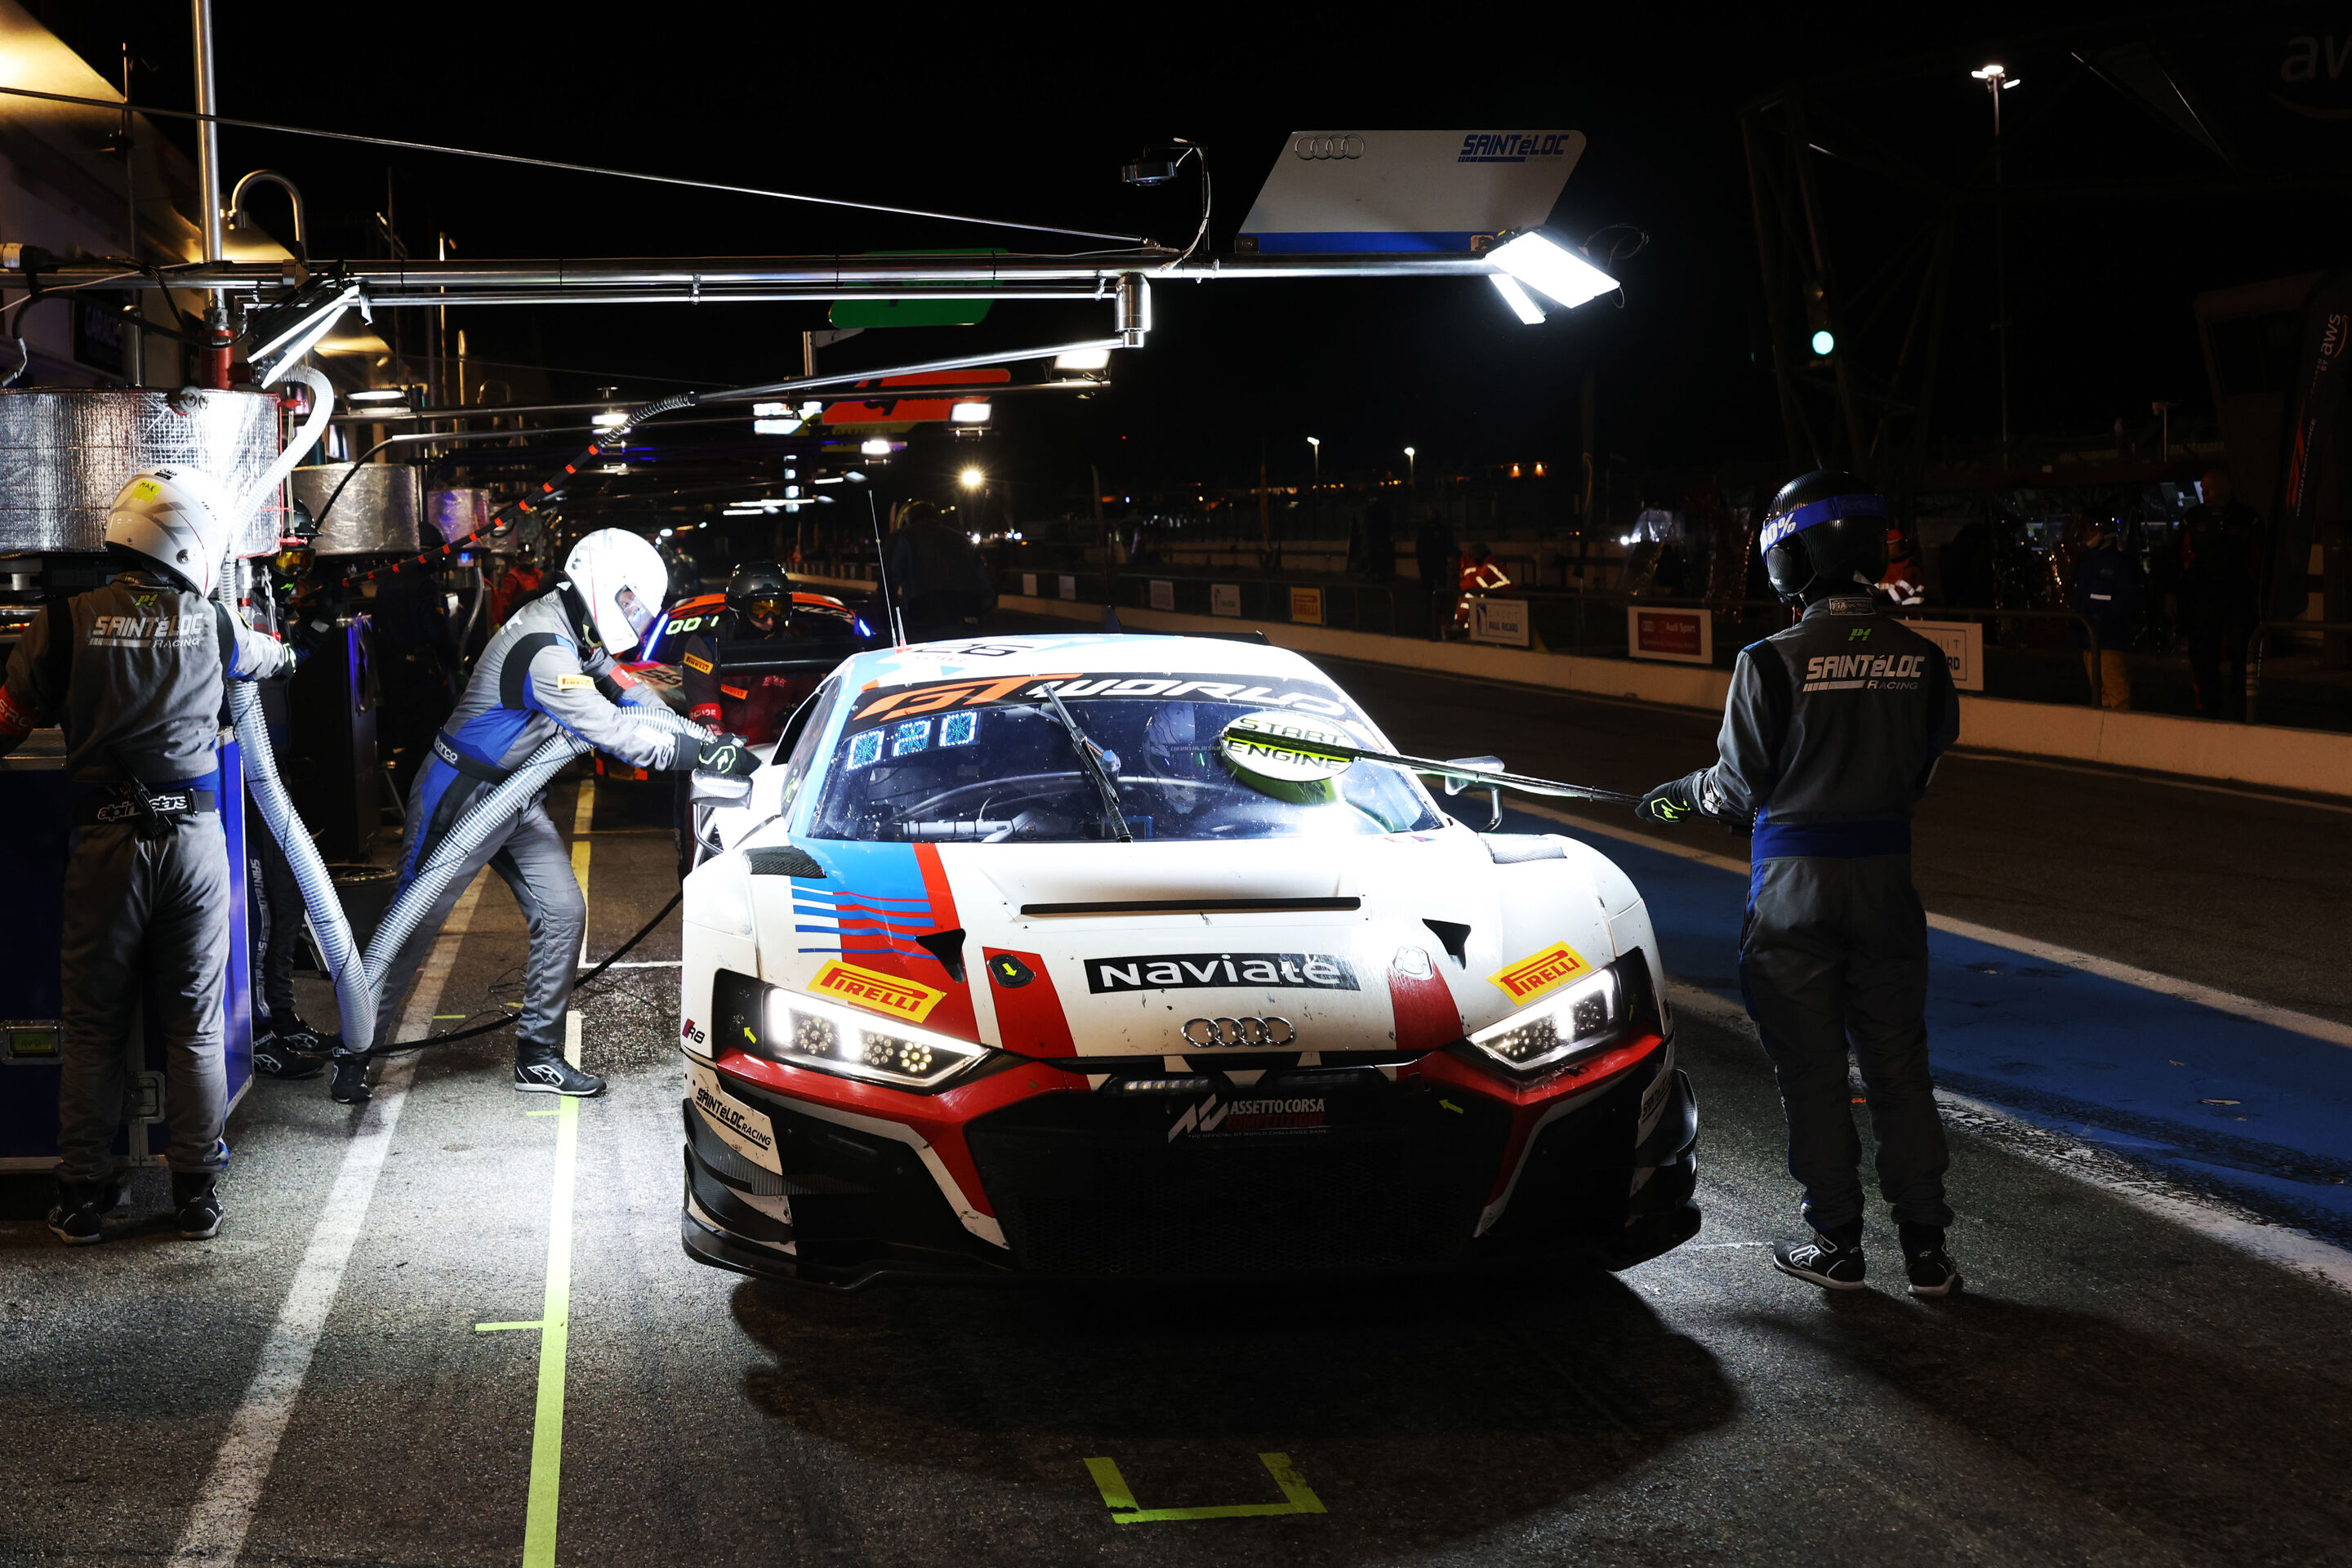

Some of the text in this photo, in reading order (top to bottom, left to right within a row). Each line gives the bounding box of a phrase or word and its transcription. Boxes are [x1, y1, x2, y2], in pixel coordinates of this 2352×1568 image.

[2280, 34, 2352, 82] aw
[138, 481, 155, 492] MAX
[1239, 717, 1348, 744] START
[1227, 739, 1343, 772] ENGINE
[1500, 950, 1581, 997] PIRELLI
[820, 967, 929, 1013] PIRELLI
[688, 1025, 706, 1045] R8
[1229, 1098, 1325, 1116] ASSETTO CORSA
[741, 1121, 772, 1146] RACING
[1226, 1113, 1325, 1130] COMPETIZIONE
